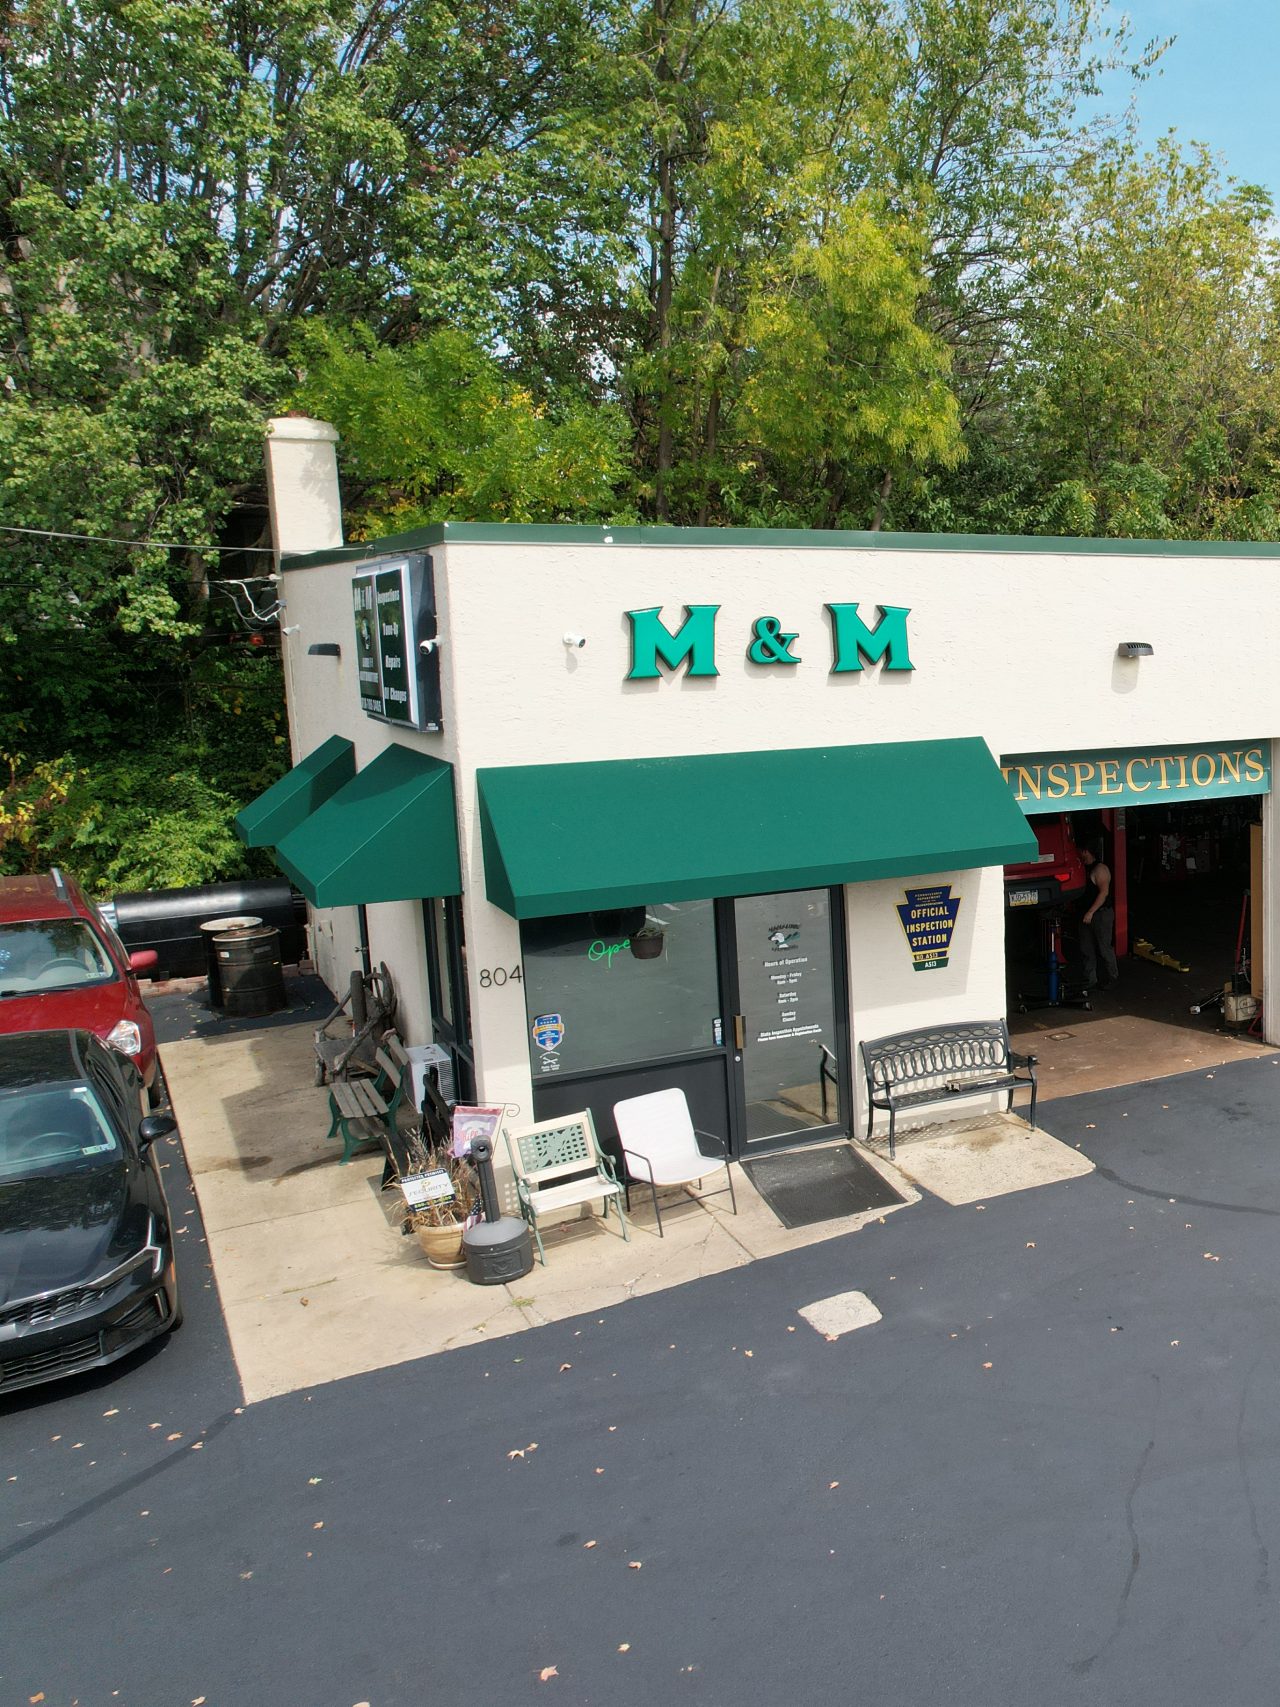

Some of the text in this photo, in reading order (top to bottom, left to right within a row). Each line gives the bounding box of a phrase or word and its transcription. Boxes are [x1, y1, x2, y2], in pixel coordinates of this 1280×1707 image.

[624, 603, 915, 680] M & M
[911, 906, 949, 919] OFFICIAL
[907, 920, 953, 933] INSPECTION
[912, 934, 947, 947] STATION
[588, 938, 631, 968] Ope
[785, 957, 807, 966] Operation
[479, 965, 523, 988] 804
